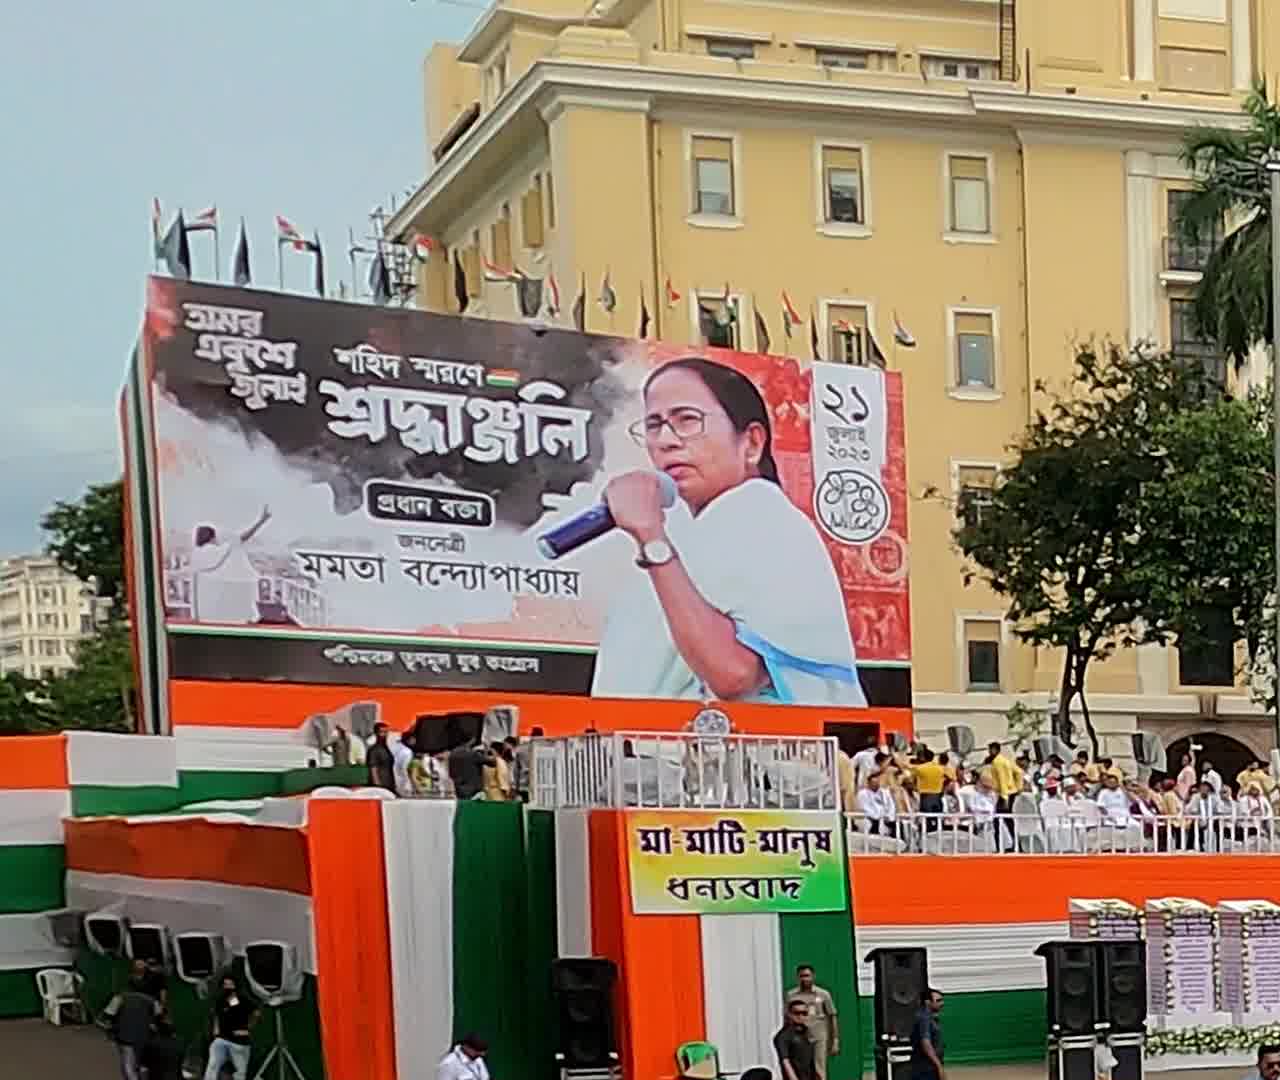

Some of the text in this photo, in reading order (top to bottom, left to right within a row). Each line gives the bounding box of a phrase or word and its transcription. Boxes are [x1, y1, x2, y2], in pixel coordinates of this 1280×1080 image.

[182, 303, 264, 337] অমর
[195, 335, 297, 373] একুশে
[333, 344, 486, 387] শহিদ স্মরণে
[228, 371, 307, 410] জুলাই
[822, 384, 869, 424] ২১
[319, 380, 592, 464] শ্রদ্ধাঞ্জলি
[827, 446, 871, 462] ২০২৩
[376, 493, 432, 516] প্রধান
[296, 552, 579, 596] মমতা বন্দ্যোপাধ্যায়
[666, 876, 804, 901] ধন্যবাদ
